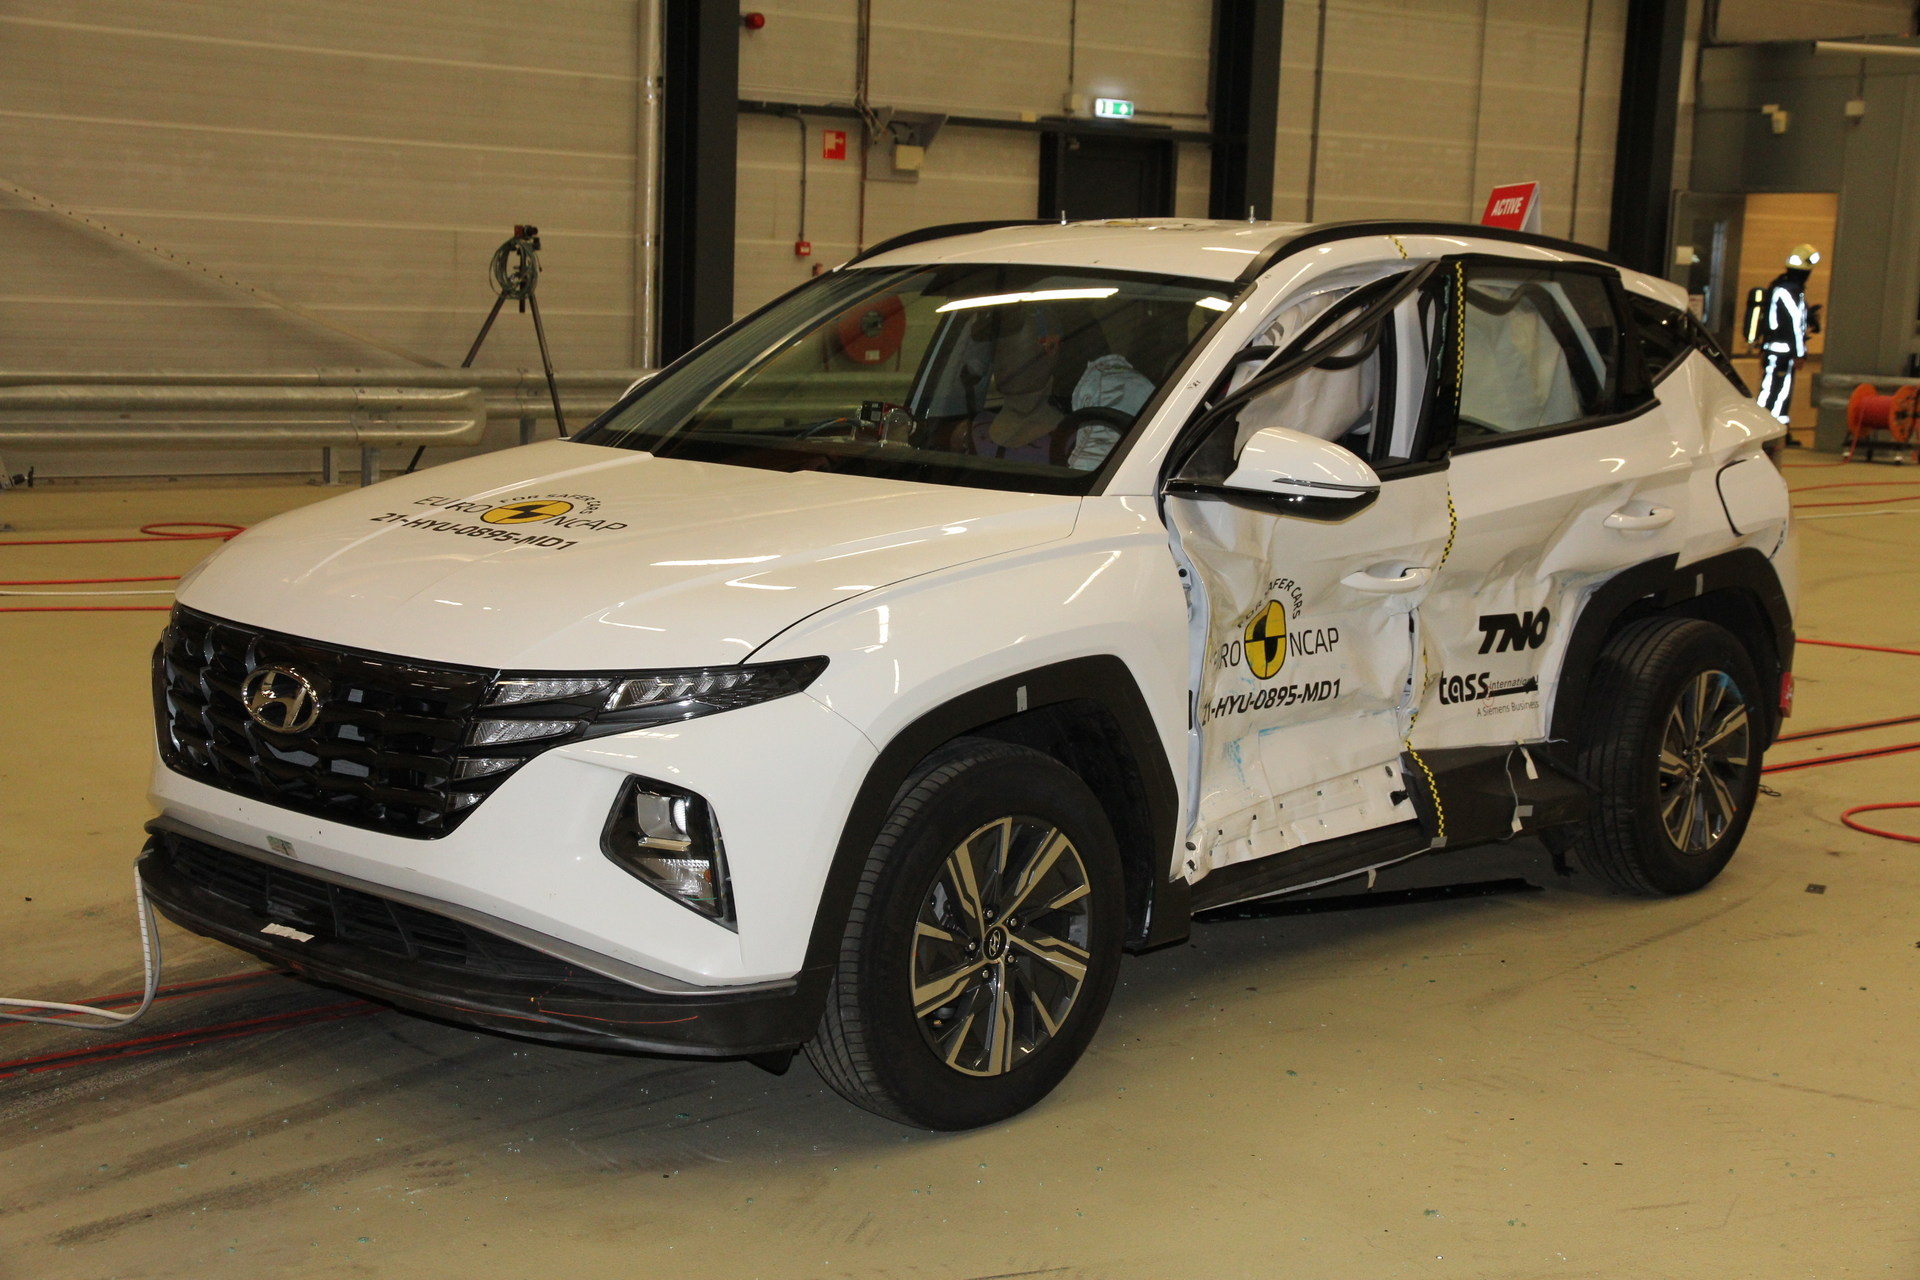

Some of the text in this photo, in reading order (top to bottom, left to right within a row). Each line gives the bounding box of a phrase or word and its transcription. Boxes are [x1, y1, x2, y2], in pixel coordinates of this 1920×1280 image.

[1491, 197, 1524, 216] ACTIVE
[370, 512, 579, 550] 21-HYU-0895-MD1
[413, 496, 628, 532] EURO NCAP
[1291, 586, 1303, 620] CARS
[1289, 627, 1340, 657] NCAP
[1478, 606, 1550, 654] TNO
[1202, 678, 1341, 727] 21-HYU-0895-MD1
[1439, 670, 1490, 705] tass
[1483, 705, 1510, 716] Siemens
[1511, 701, 1540, 711] Business
